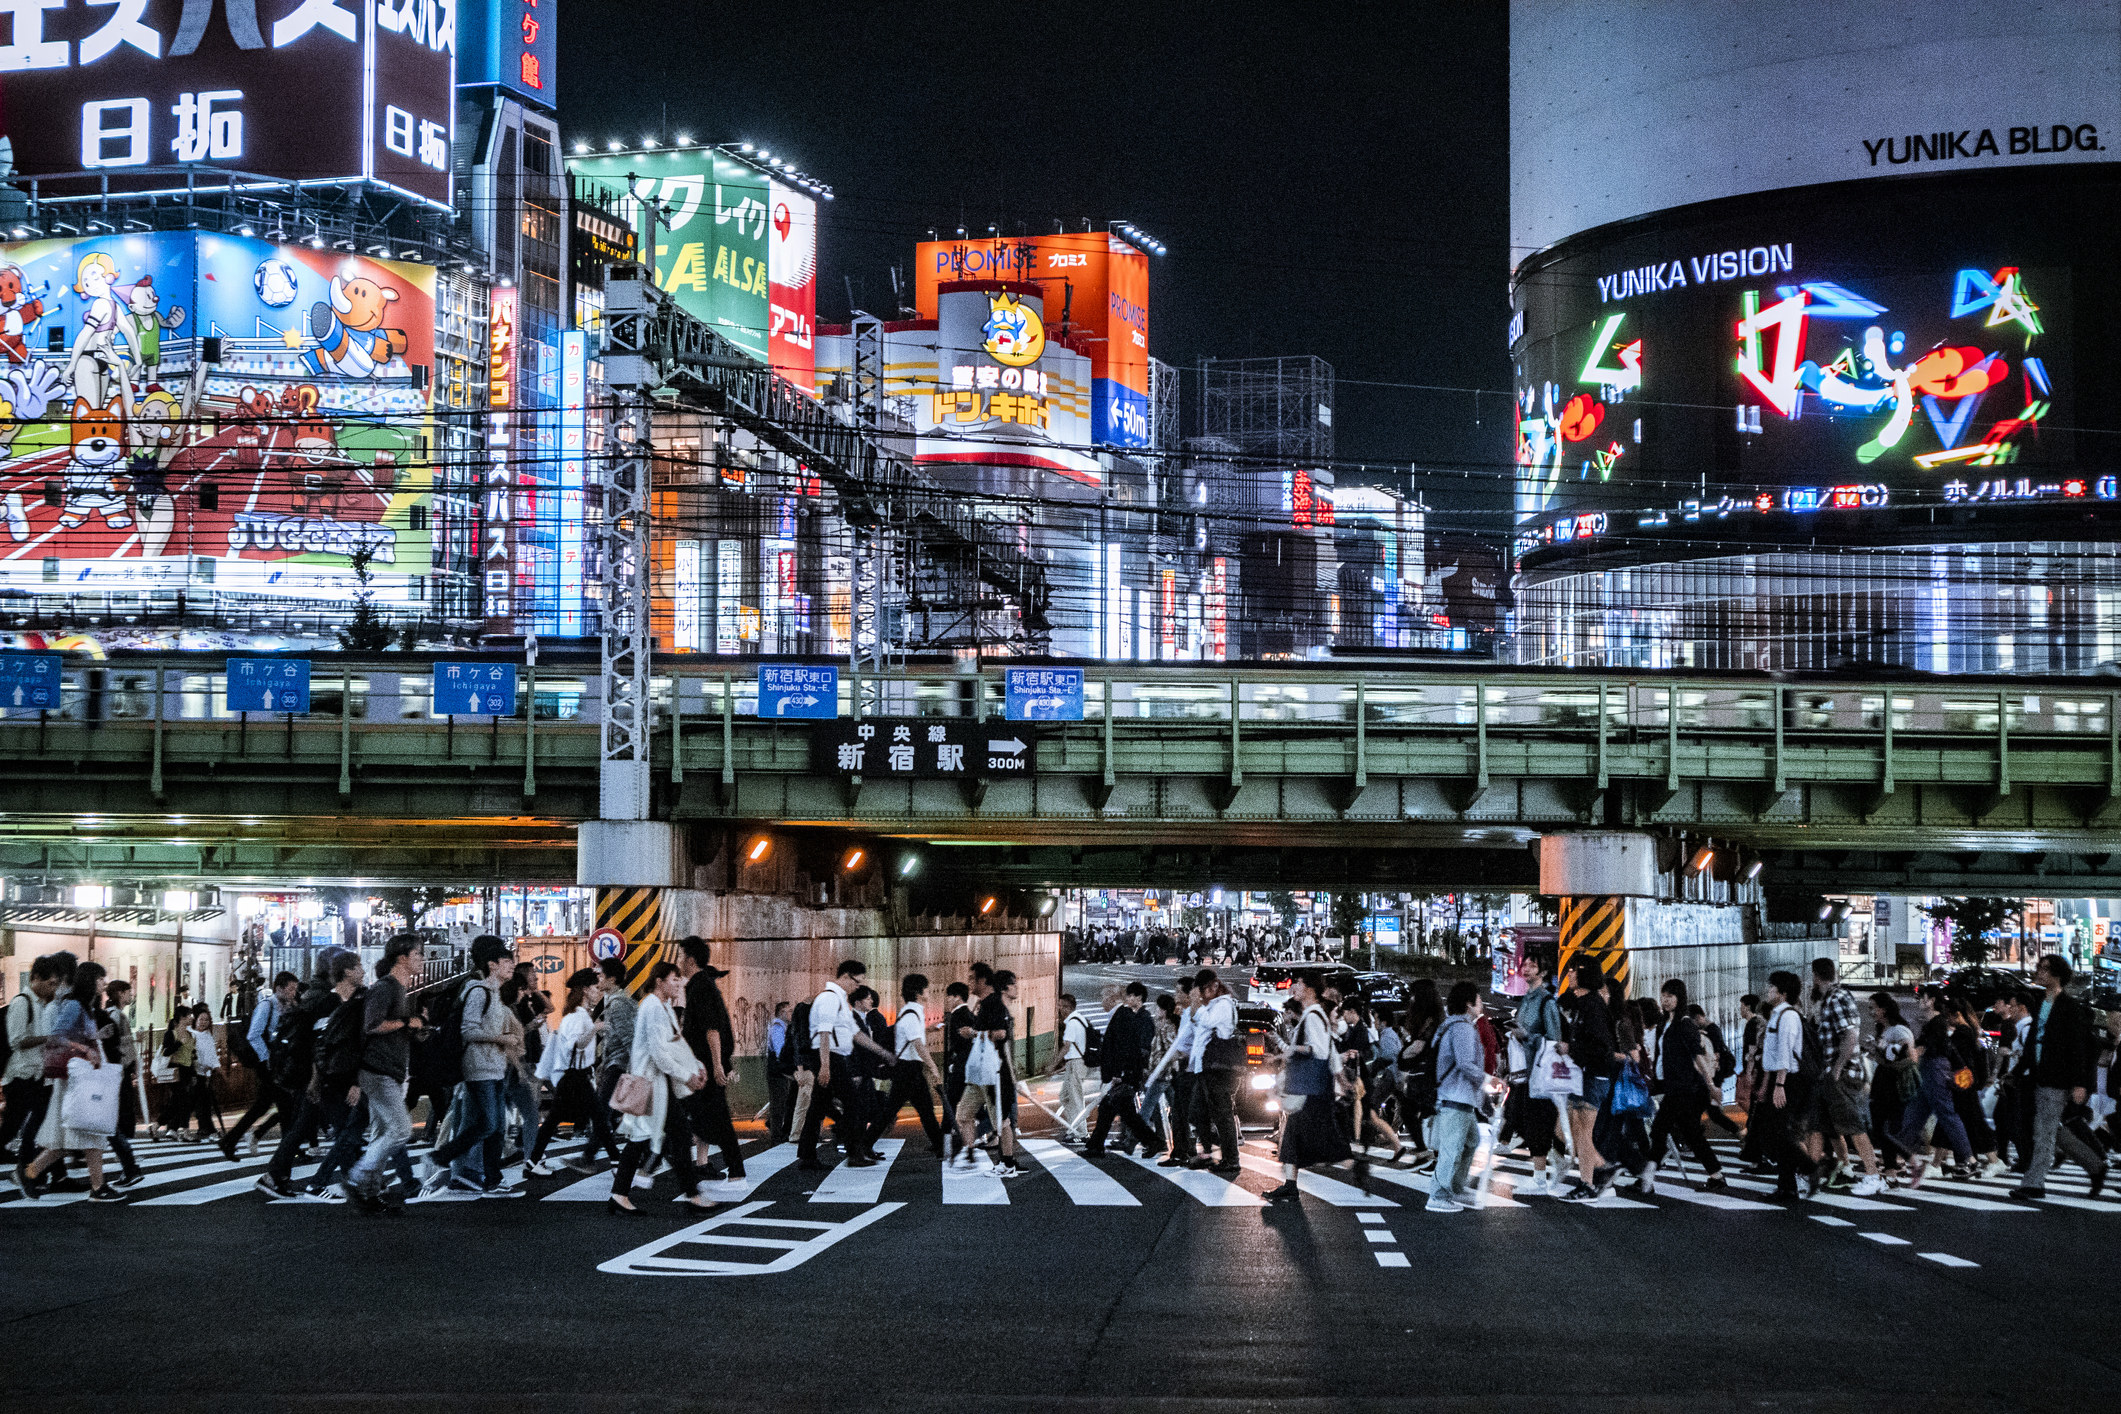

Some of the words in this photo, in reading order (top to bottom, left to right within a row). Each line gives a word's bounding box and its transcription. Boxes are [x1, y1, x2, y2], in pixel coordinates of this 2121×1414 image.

[521, 0, 542, 90] ケ館
[82, 89, 244, 169] 日拓
[385, 104, 446, 171] 日拓
[1862, 128, 2000, 166] YUNIKA
[2009, 123, 2106, 154] BLDG.
[715, 183, 766, 240] レイク
[713, 245, 767, 299] ALSA
[936, 247, 1038, 274] PROMISE
[1048, 253, 1088, 268] プロミス
[1598, 260, 1687, 303] YUNIKA
[1691, 242, 1793, 285] VISION
[770, 302, 812, 350] アコム
[1111, 291, 1145, 332] PROMISE
[489, 299, 512, 406] パチンコ
[1123, 407, 1146, 440] 50m
[453, 681, 496, 691] Ichigaya
[767, 683, 801, 692] Shinjuku
[1013, 685, 1047, 695] Shinjuku
[857, 723, 946, 742] 中央線
[837, 743, 964, 771] 新宿駅
[988, 757, 1025, 770] 300M
[532, 957, 562, 971] KRT
